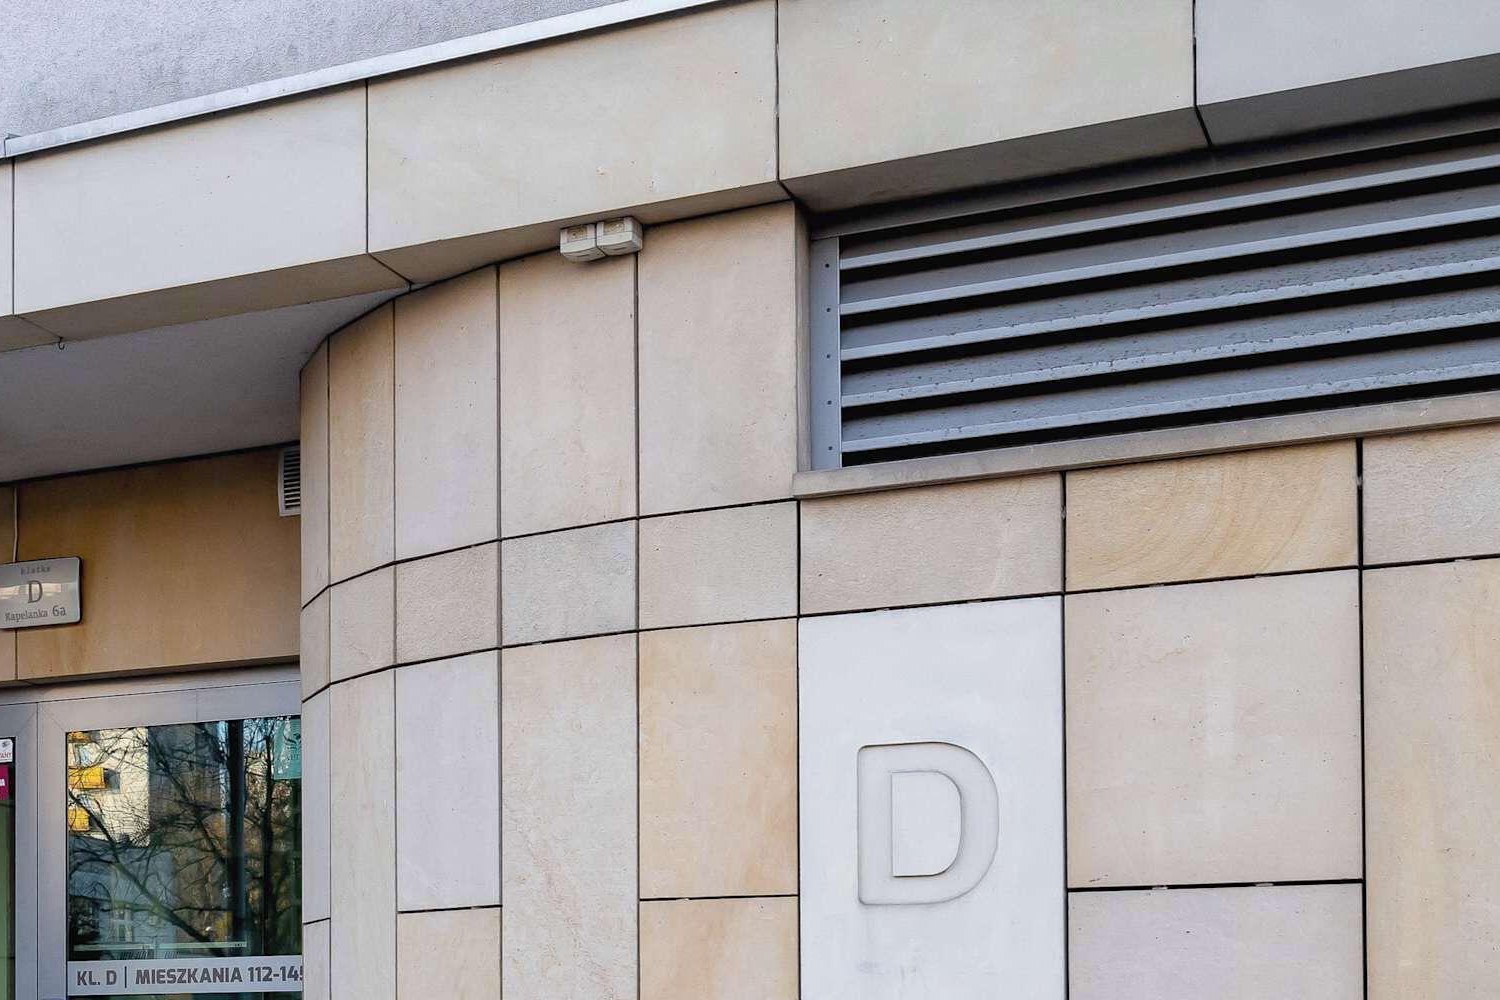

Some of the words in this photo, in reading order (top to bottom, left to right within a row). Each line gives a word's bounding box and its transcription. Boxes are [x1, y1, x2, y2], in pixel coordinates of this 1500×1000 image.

[28, 580, 43, 604] D
[4, 608, 48, 622] Kapelanka
[52, 604, 66, 617] 6a
[857, 741, 999, 905] D
[77, 970, 101, 986] KL.
[106, 970, 117, 985] D
[135, 967, 243, 985] MIESZKANIA
